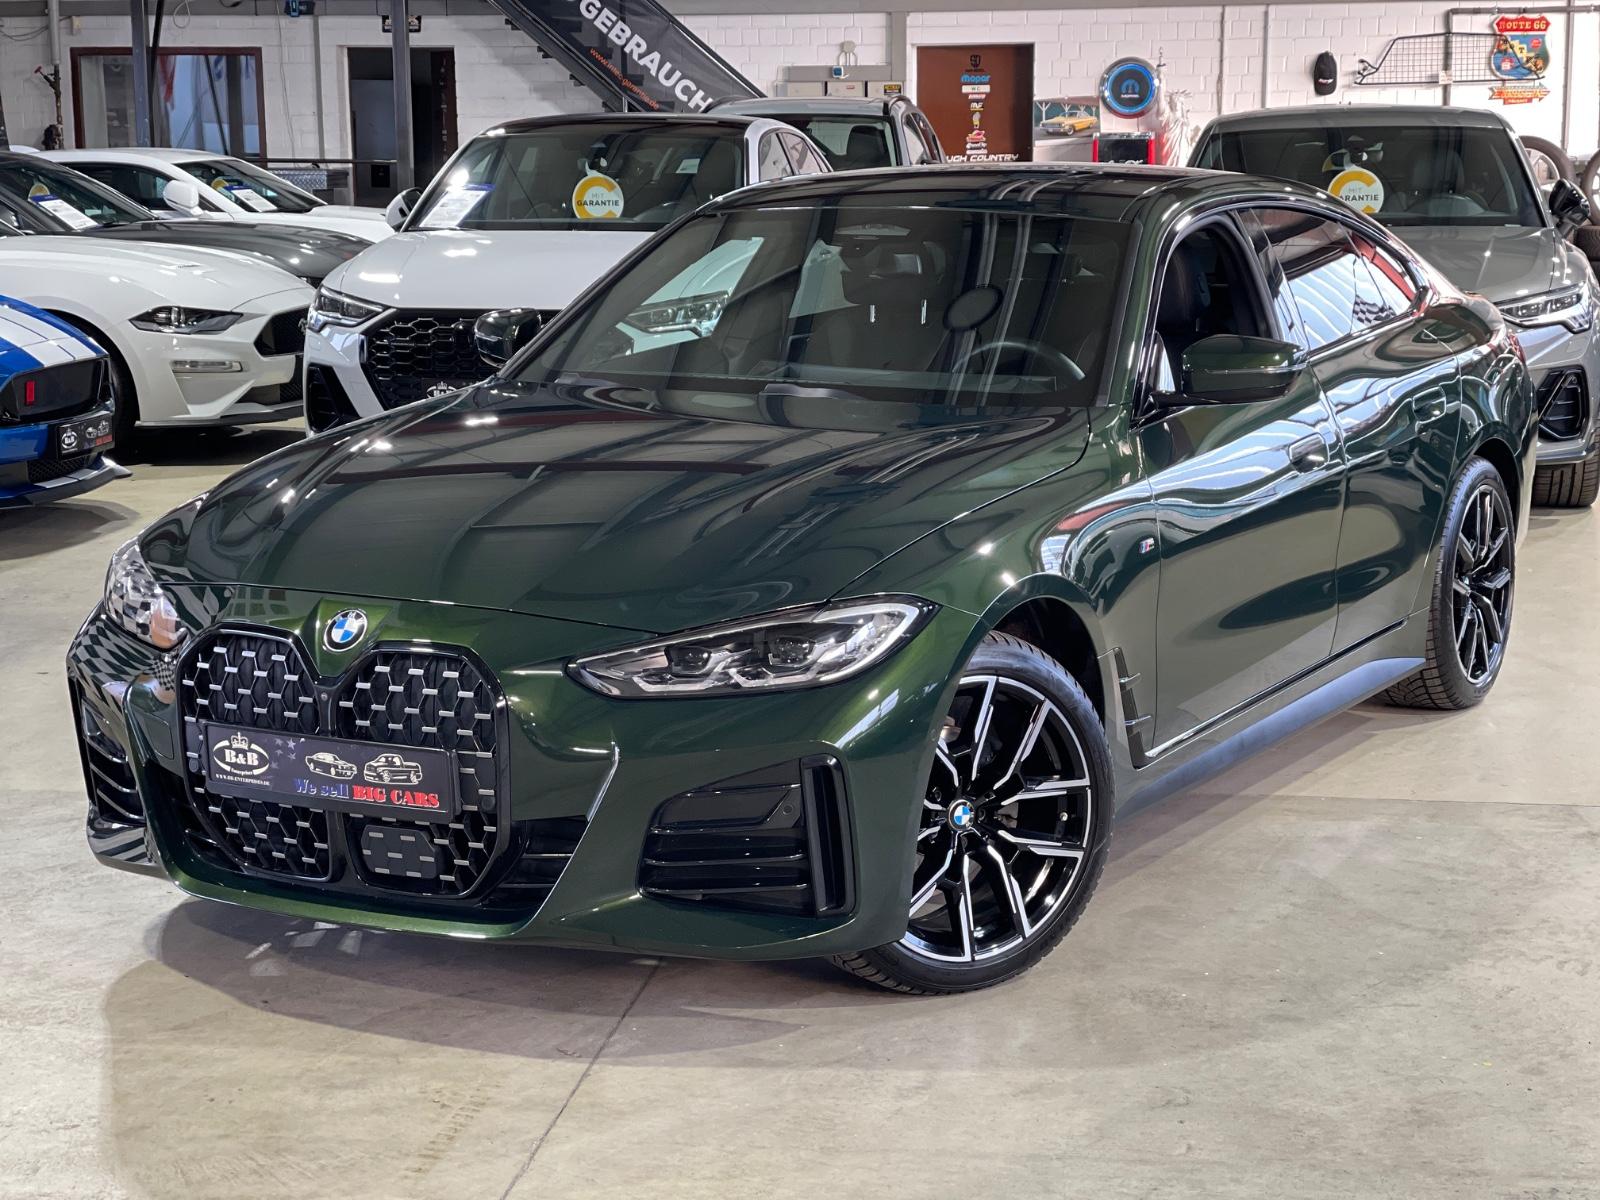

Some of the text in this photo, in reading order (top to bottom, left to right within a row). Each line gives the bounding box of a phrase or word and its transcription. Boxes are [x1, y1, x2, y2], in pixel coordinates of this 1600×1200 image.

[1499, 21, 1546, 30] ROUTE 66
[969, 153, 1019, 162] COUNTRY
[576, 199, 620, 207] GARANTIE
[224, 748, 259, 766] B&B
[294, 777, 440, 808] We sell BIG CARS
